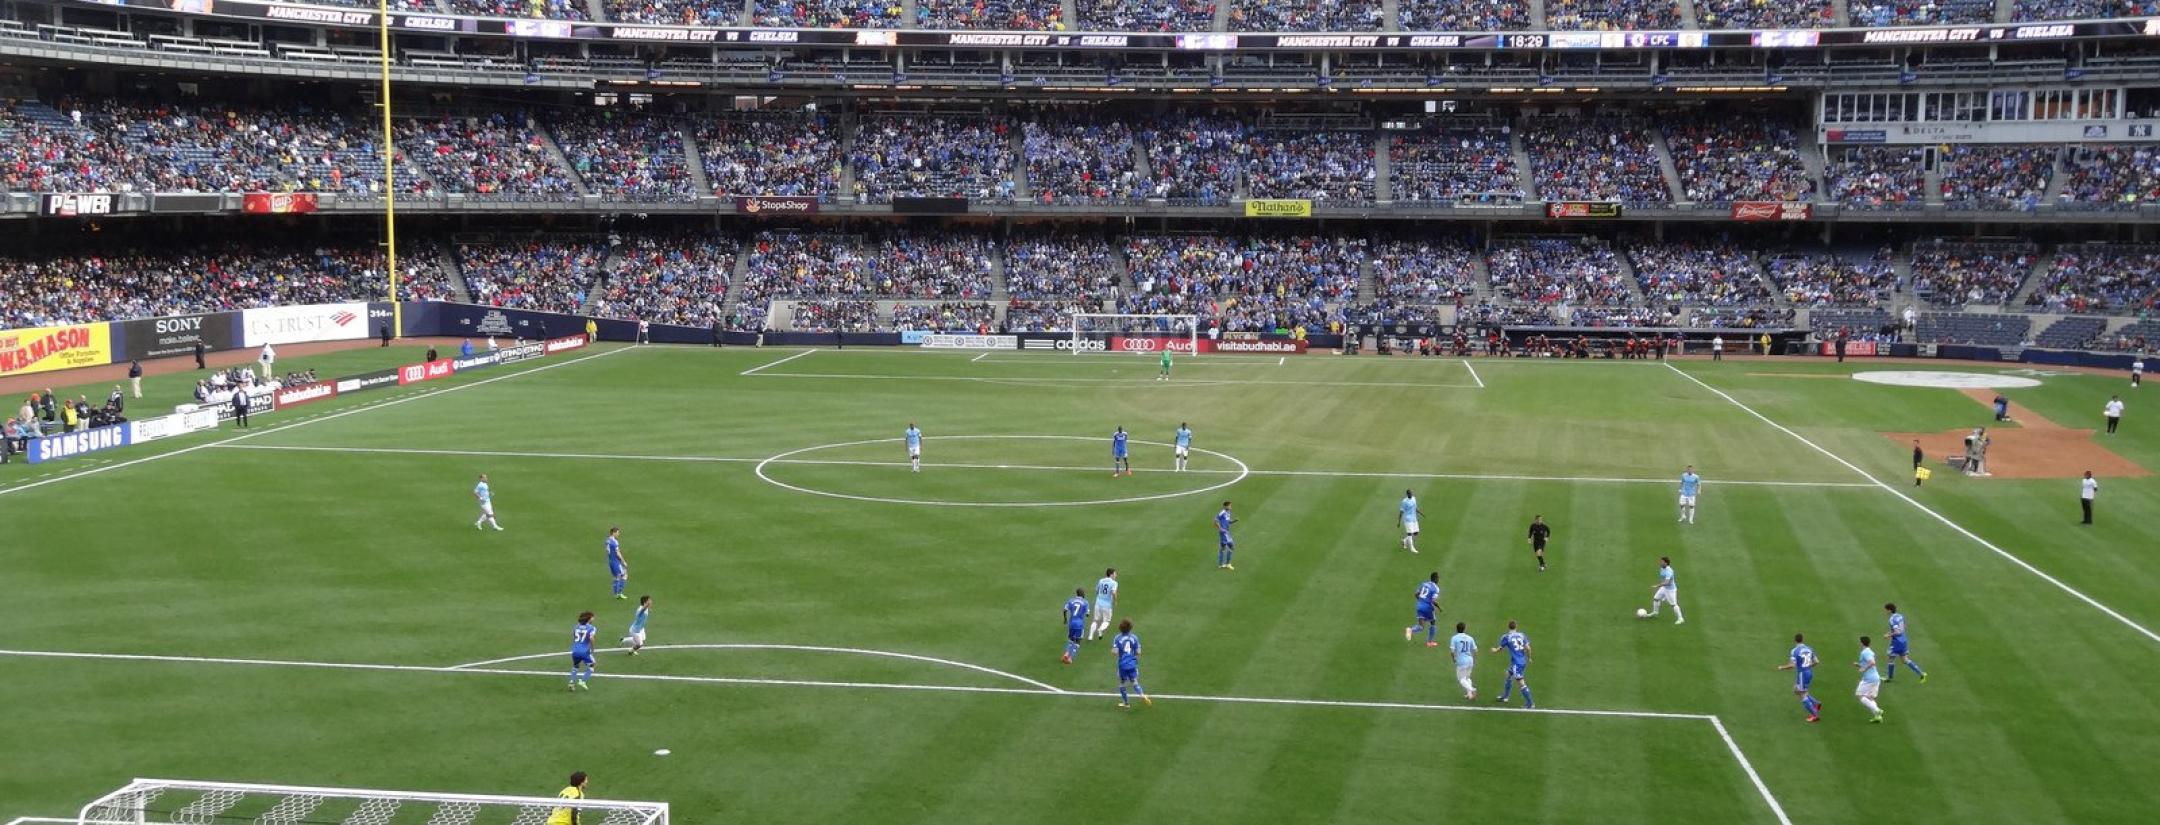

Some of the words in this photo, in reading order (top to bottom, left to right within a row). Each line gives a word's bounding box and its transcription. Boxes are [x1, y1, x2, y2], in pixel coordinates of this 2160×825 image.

[266, 6, 342, 24] MANCHESTER
[343, 12, 372, 25] CITY
[405, 18, 454, 29] CHELSEA
[612, 27, 689, 40] MANCHESTER
[690, 29, 717, 41] CITY
[750, 31, 798, 42] CHELSEA
[949, 34, 1022, 45] MANCHESTER
[1023, 34, 1049, 46] CITY
[1080, 35, 1127, 46] CHELSEA
[1651, 34, 1669, 45] CFC
[1864, 29, 1947, 43] MANCHESTER
[1949, 28, 1981, 40] CITY
[2016, 25, 2073, 38] CHELSEA
[1277, 36, 1350, 46] MANCHESTER
[1351, 36, 1378, 46] CITY
[1410, 36, 1459, 46] CHELSEA
[1508, 35, 1543, 47] 18:29
[50, 195, 111, 214] PWER
[1252, 201, 1304, 214] Nathan's
[156, 317, 204, 333] SONY
[277, 315, 323, 333] TRUST
[1167, 340, 1193, 351] Aud
[1216, 341, 1297, 352] visitabudhabi.ae
[429, 362, 448, 375] Audi
[40, 426, 122, 460] SAMSUNG
[1073, 604, 1080, 616] 7
[574, 628, 588, 642] 57
[1124, 641, 1132, 653] 4
